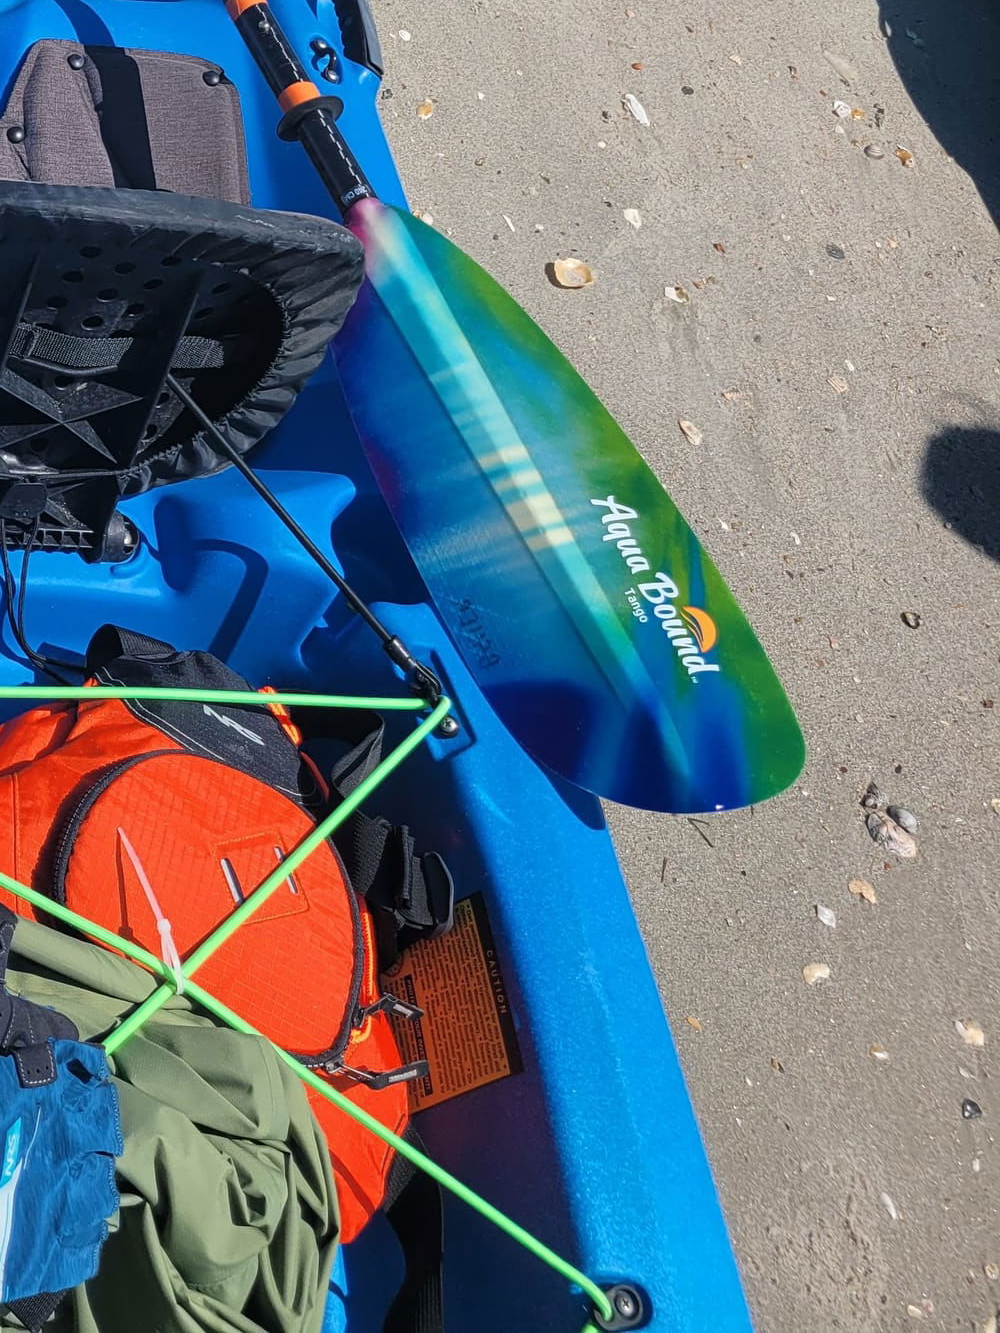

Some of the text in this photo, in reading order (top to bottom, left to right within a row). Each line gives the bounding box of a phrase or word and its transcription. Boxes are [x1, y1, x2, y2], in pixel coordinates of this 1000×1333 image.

[590, 495, 720, 675] Aqua Bound
[624, 588, 648, 624] Tango
[485, 948, 507, 1014] CAUTION
[5, 1133, 17, 1176] NRS
